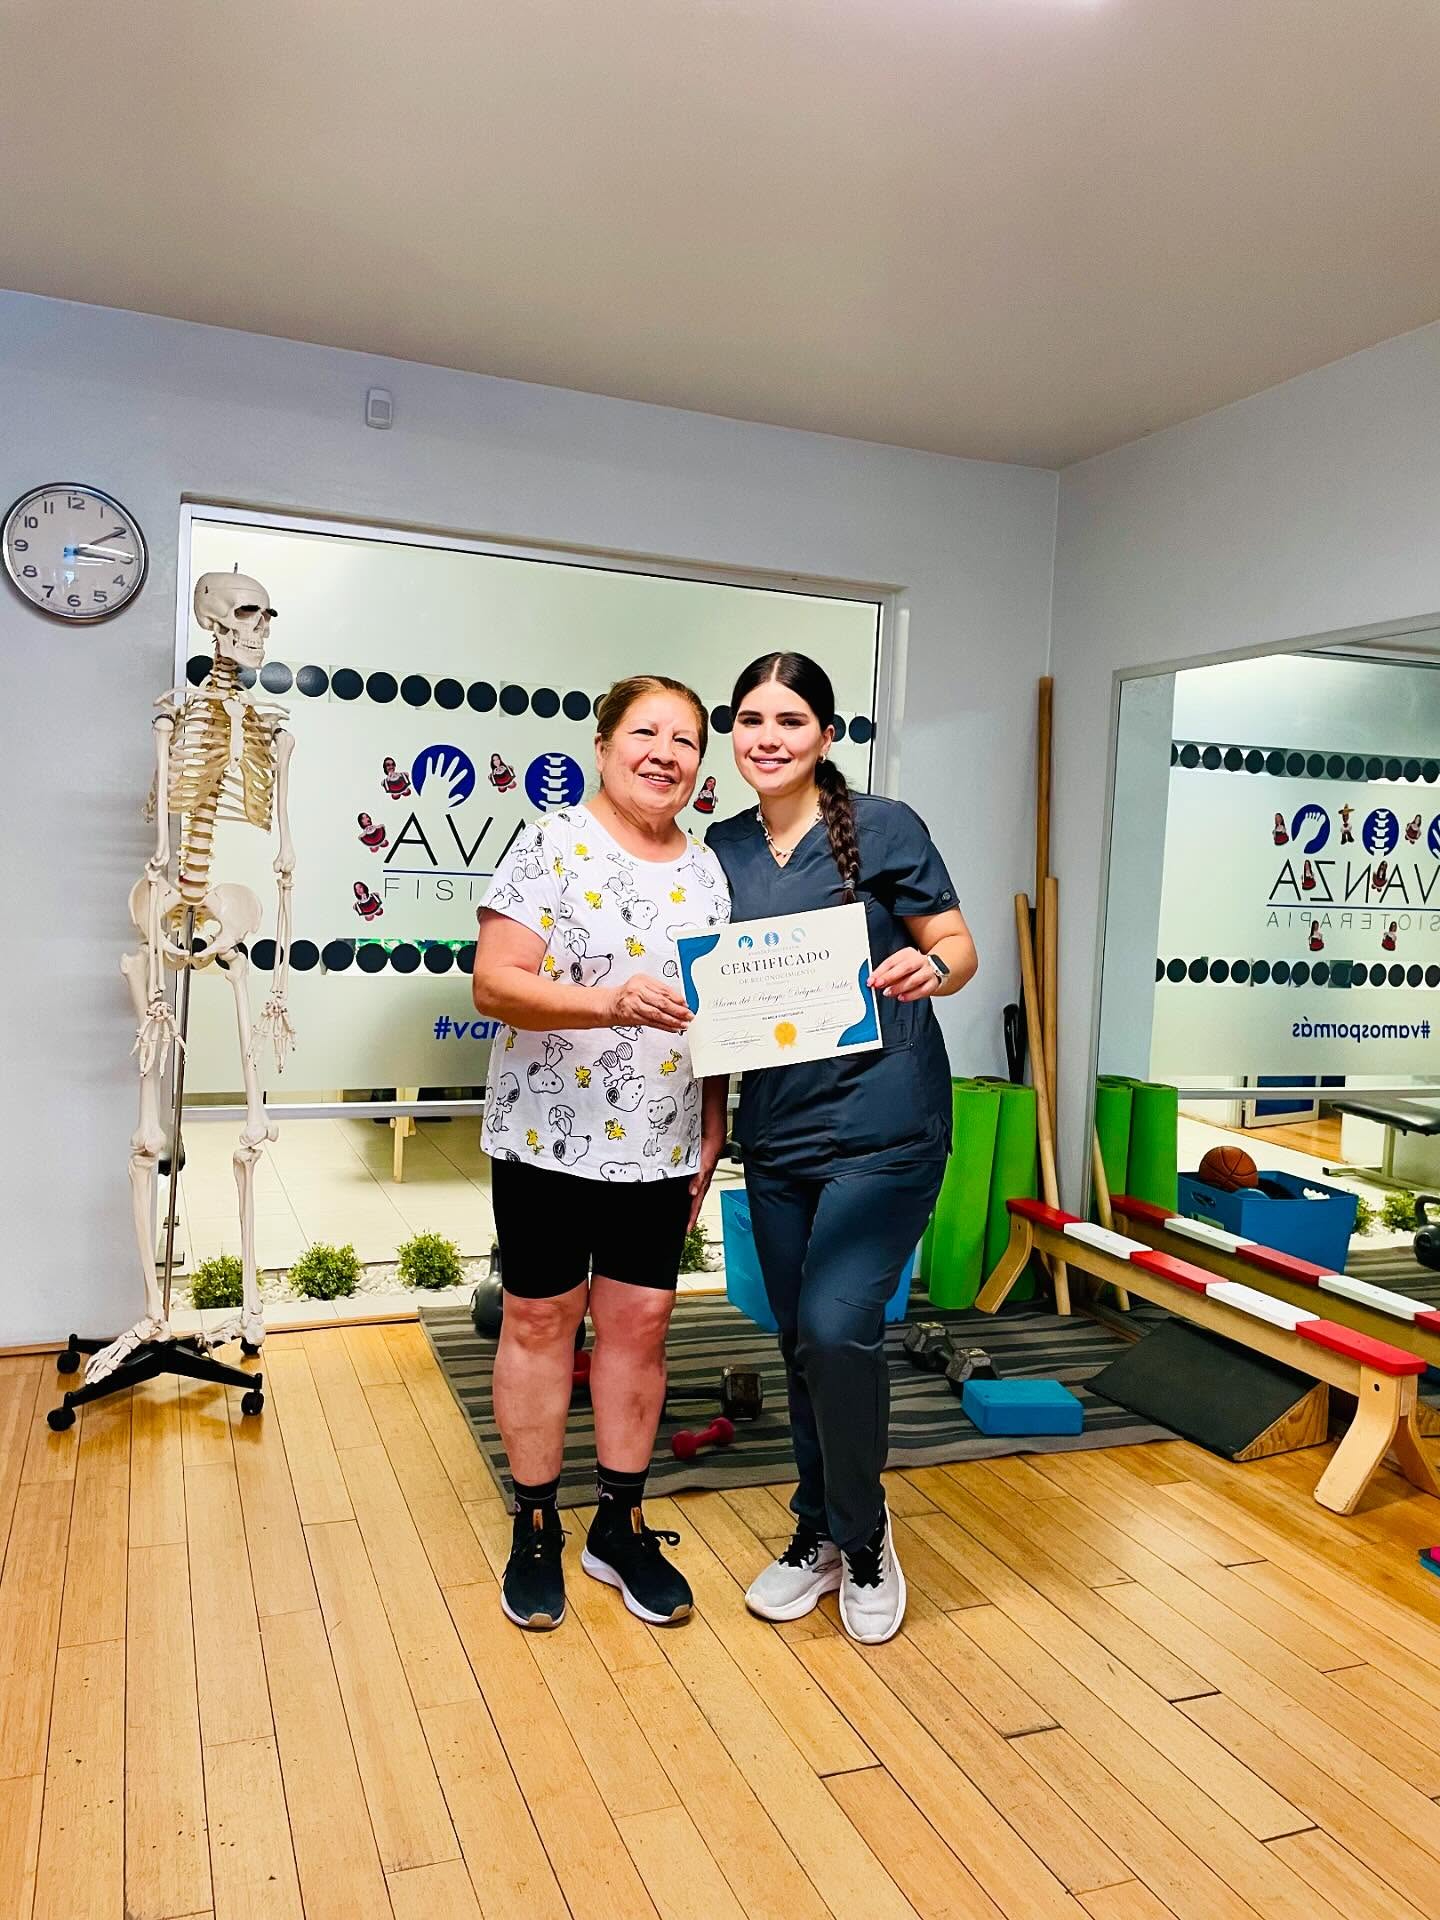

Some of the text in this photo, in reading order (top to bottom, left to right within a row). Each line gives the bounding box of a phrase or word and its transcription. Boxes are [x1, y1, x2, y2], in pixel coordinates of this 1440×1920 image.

[44, 501, 54, 514] 11
[67, 496, 85, 510] 12
[24, 516, 38, 529] 10
[113, 527, 126, 539] 2
[14, 539, 28, 552] 9
[22, 565, 38, 578] 8
[112, 575, 125, 587] 4
[42, 585, 55, 598] 7
[93, 590, 108, 603] 5
[67, 594, 82, 607] 6
[720, 949, 831, 977] CERTIFICADO
